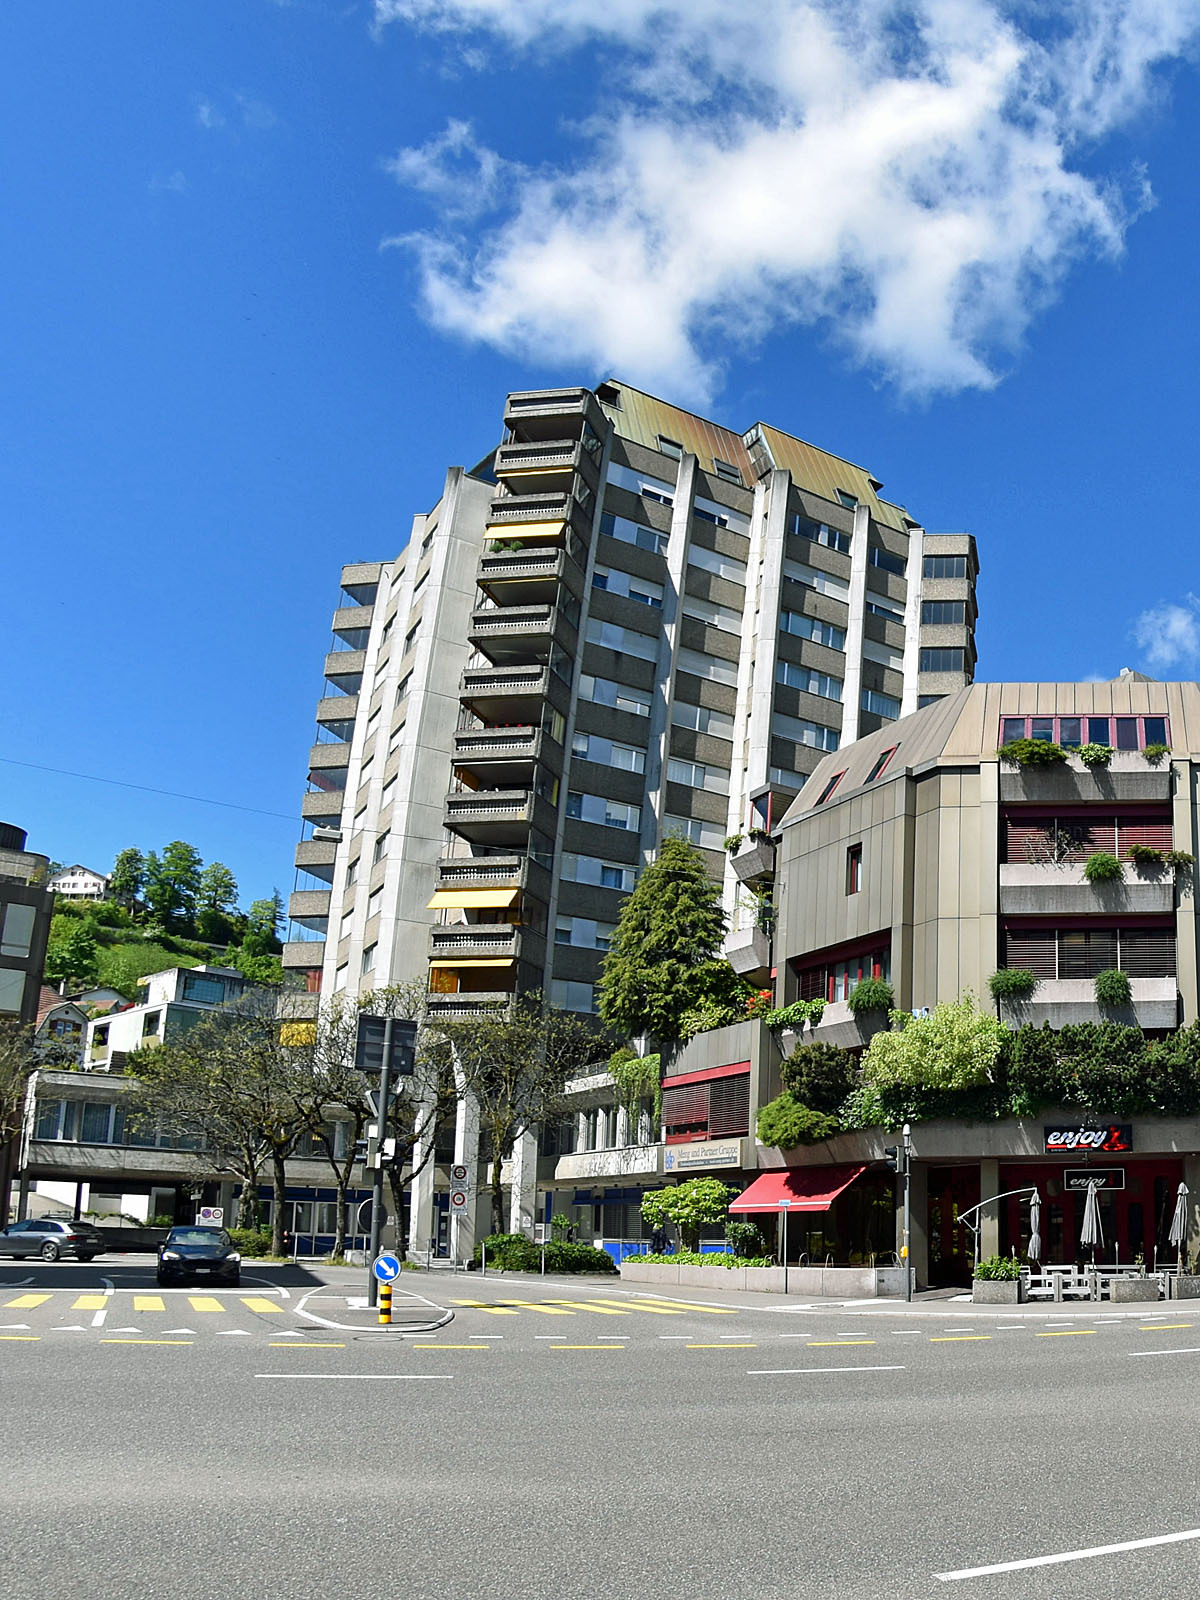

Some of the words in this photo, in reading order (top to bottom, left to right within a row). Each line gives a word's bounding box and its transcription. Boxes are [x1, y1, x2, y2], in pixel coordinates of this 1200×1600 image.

[1047, 1128, 1107, 1148] enjoy
[719, 1145, 738, 1158] Gruppe
[1070, 1177, 1106, 1187] enjoy
